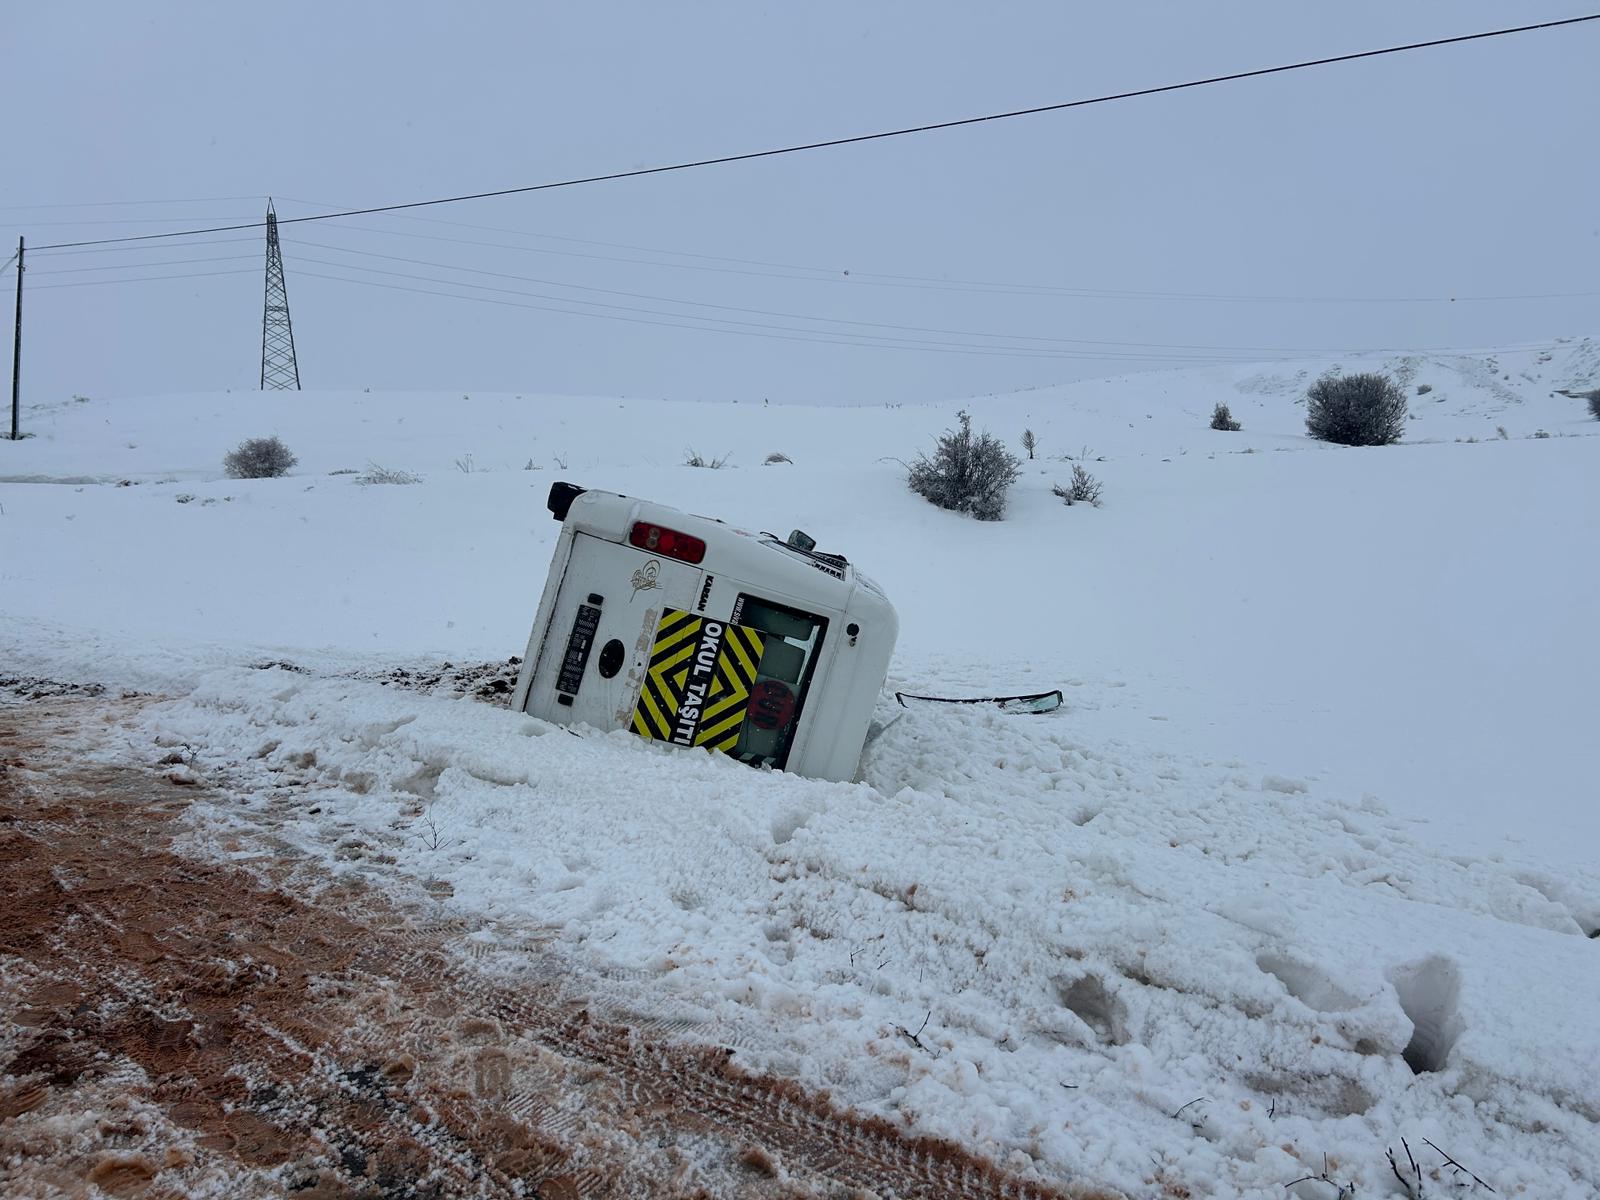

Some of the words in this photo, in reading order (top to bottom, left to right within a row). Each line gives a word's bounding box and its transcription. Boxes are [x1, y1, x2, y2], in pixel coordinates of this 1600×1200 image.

[697, 575, 714, 611] KARSAN
[730, 597, 745, 626] www.siva
[693, 622, 723, 676] OKUL
[674, 683, 707, 745] TAŞITI
